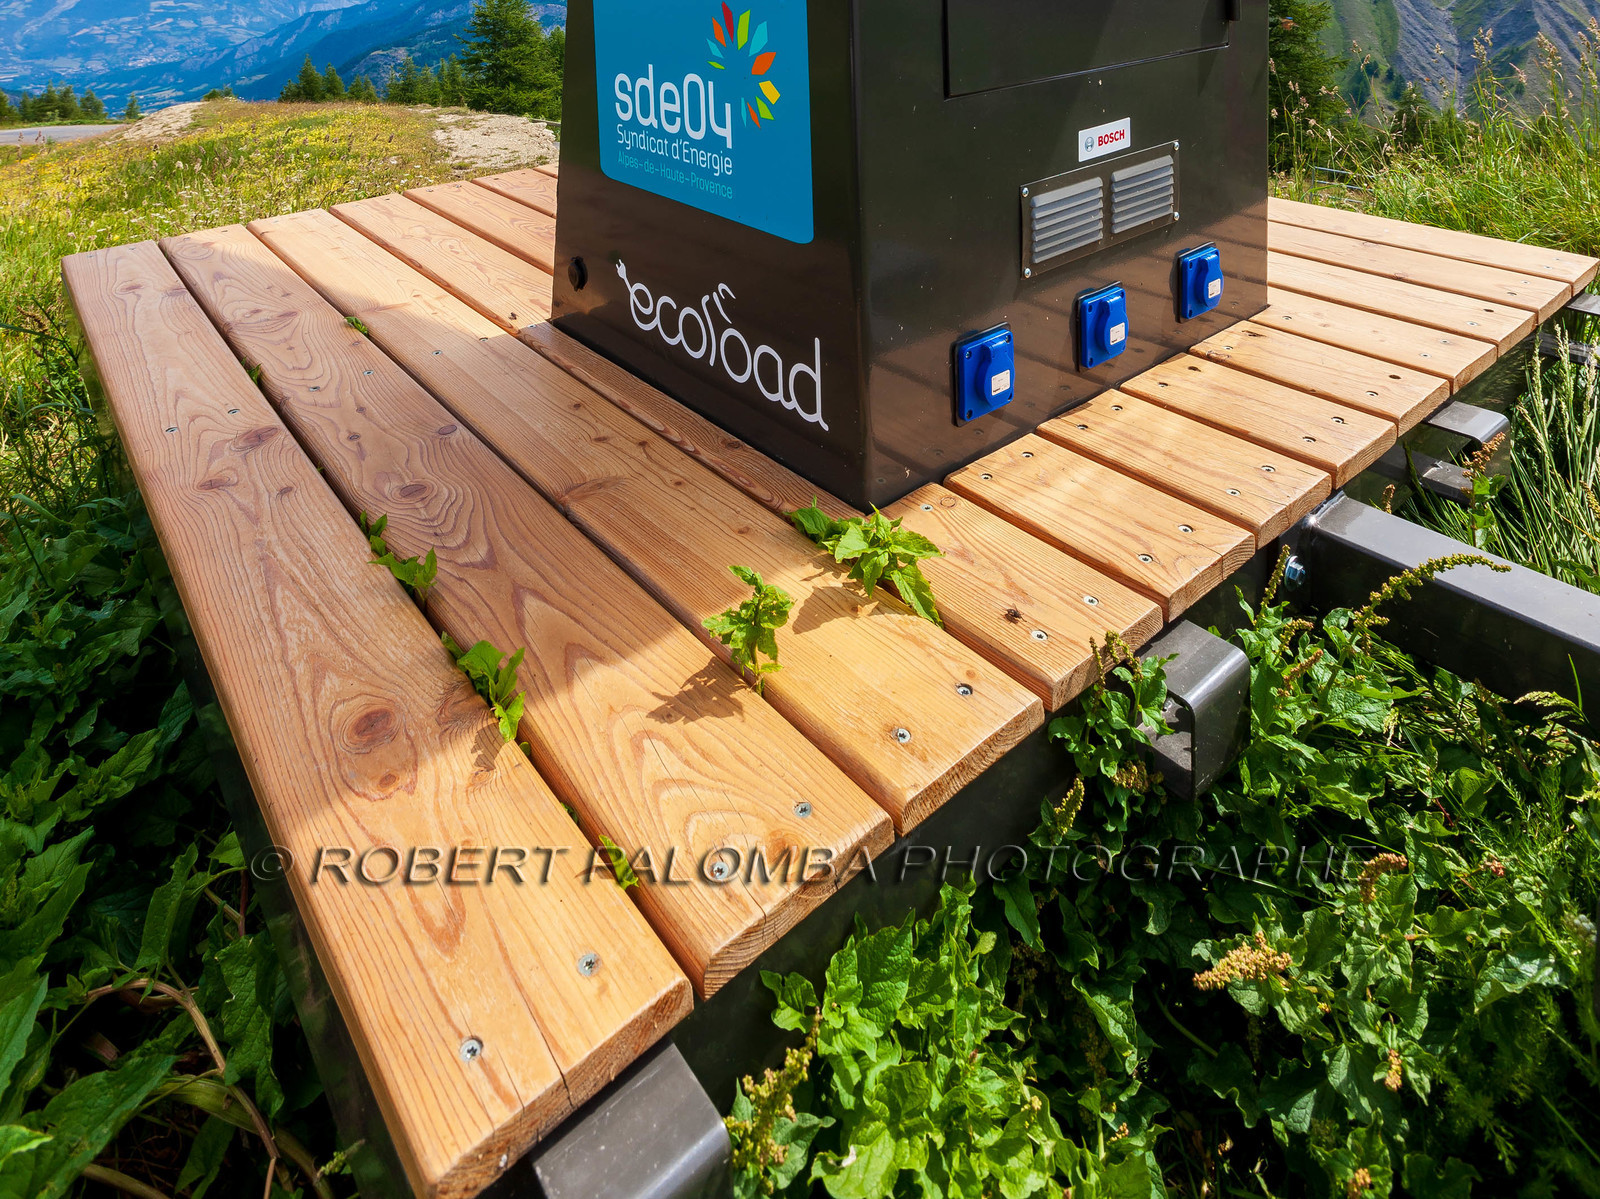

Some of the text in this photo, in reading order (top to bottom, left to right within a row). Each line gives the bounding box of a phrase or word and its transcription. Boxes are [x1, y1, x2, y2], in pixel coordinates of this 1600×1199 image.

[614, 64, 733, 149] sde04
[617, 123, 733, 176] Syndicat d’Energie
[1097, 129, 1125, 146] BOSCH
[617, 150, 733, 199] Alpes-de-Haute-Provence
[616, 259, 829, 431] ecoload
